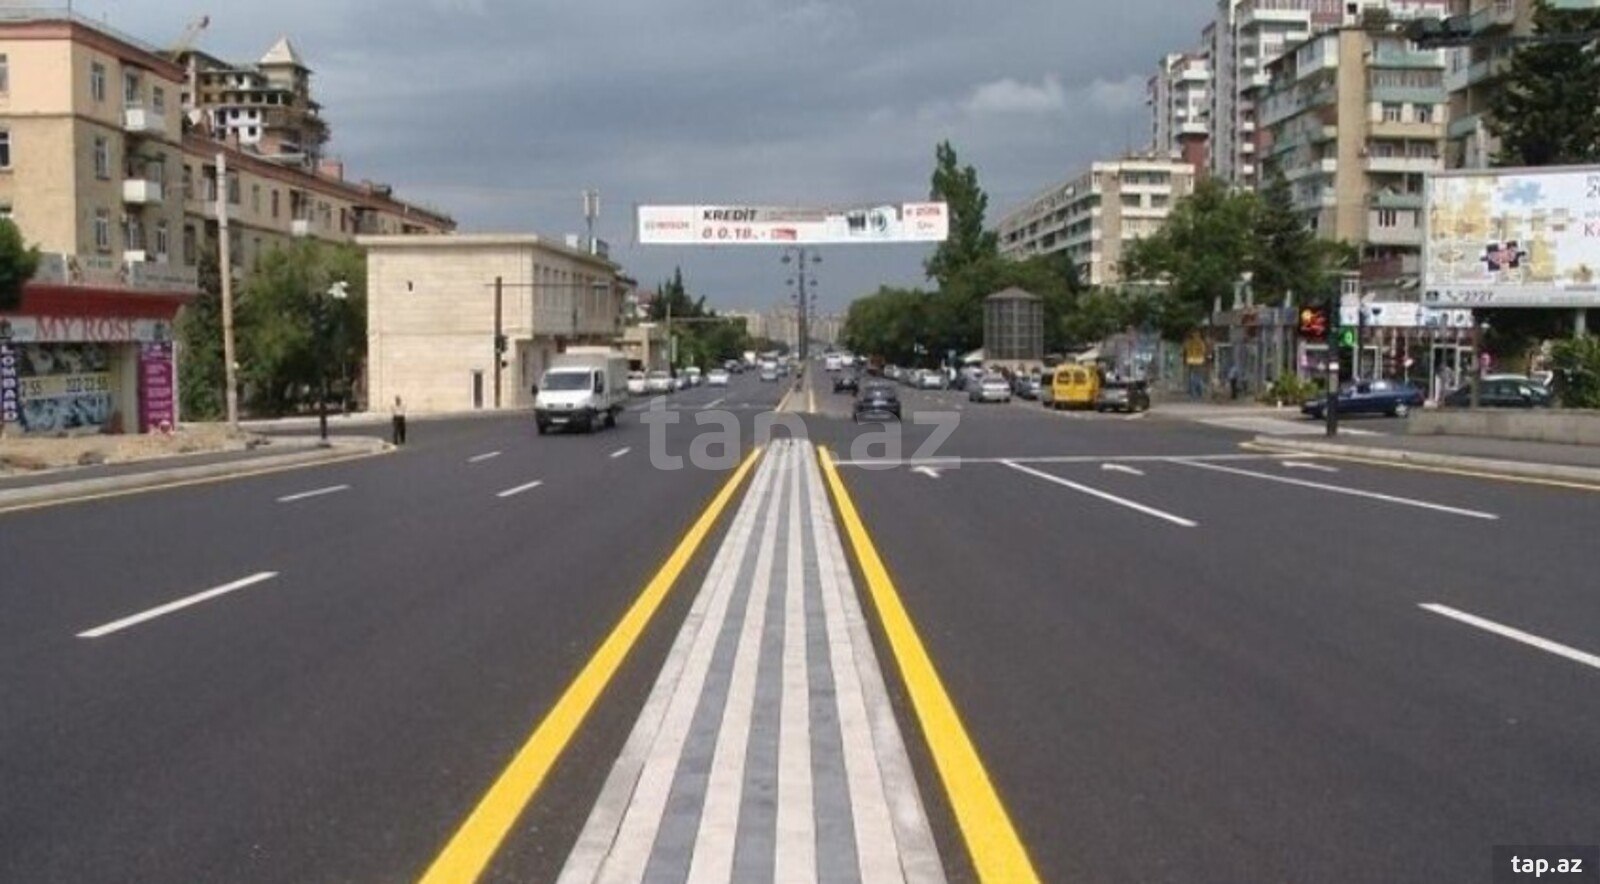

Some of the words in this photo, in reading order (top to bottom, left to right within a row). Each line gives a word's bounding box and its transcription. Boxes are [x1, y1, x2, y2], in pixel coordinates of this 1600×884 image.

[36, 316, 73, 340] MY
[83, 316, 135, 340] ROSE
[1, 344, 18, 421] LOMBARD
